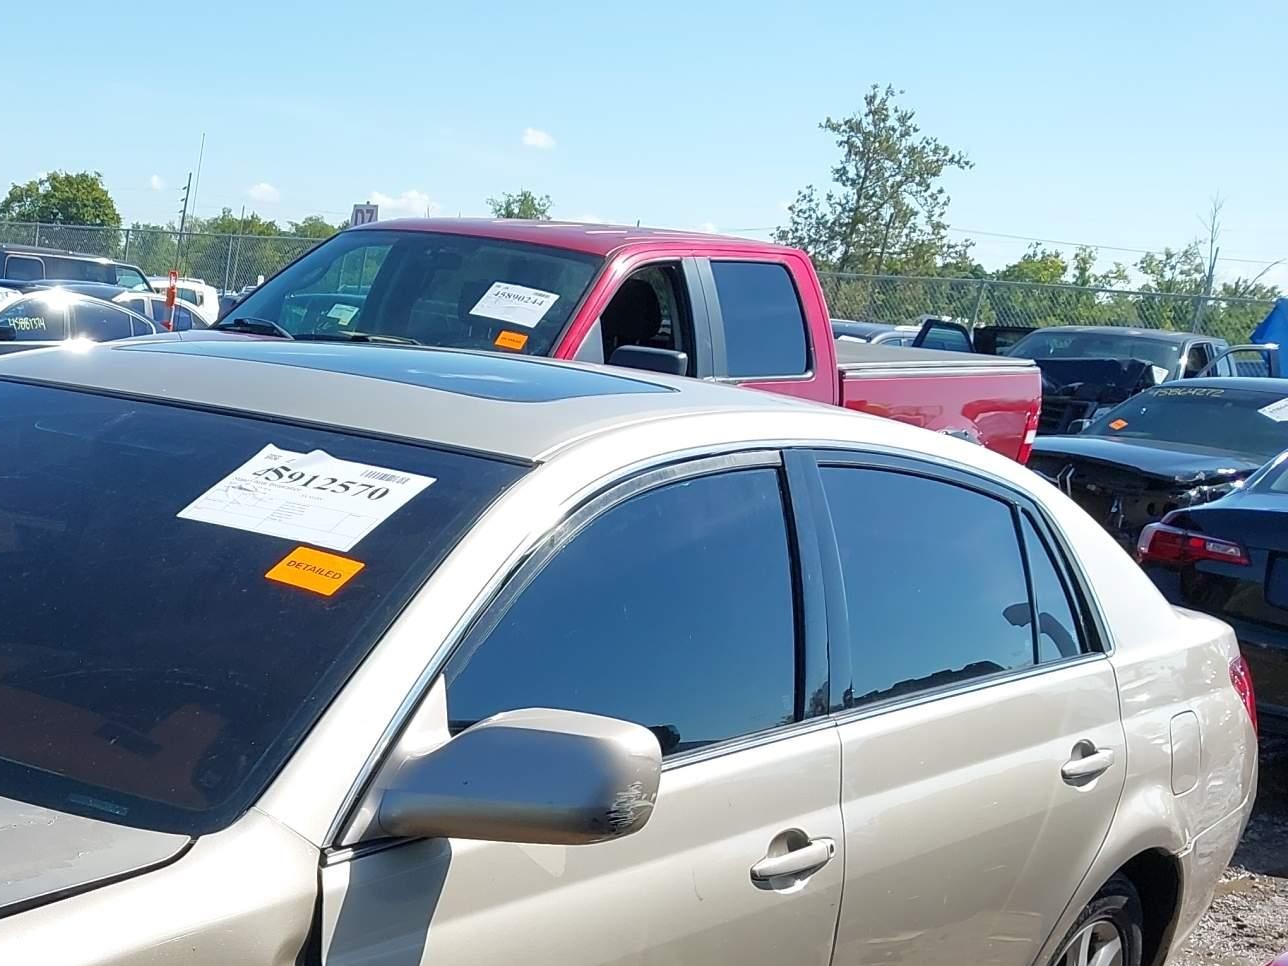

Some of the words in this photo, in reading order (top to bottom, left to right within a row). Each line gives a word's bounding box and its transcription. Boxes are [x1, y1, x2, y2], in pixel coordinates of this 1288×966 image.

[493, 290, 545, 307] 45890244
[252, 465, 389, 501] 45912570
[286, 559, 343, 581] DETAILED
